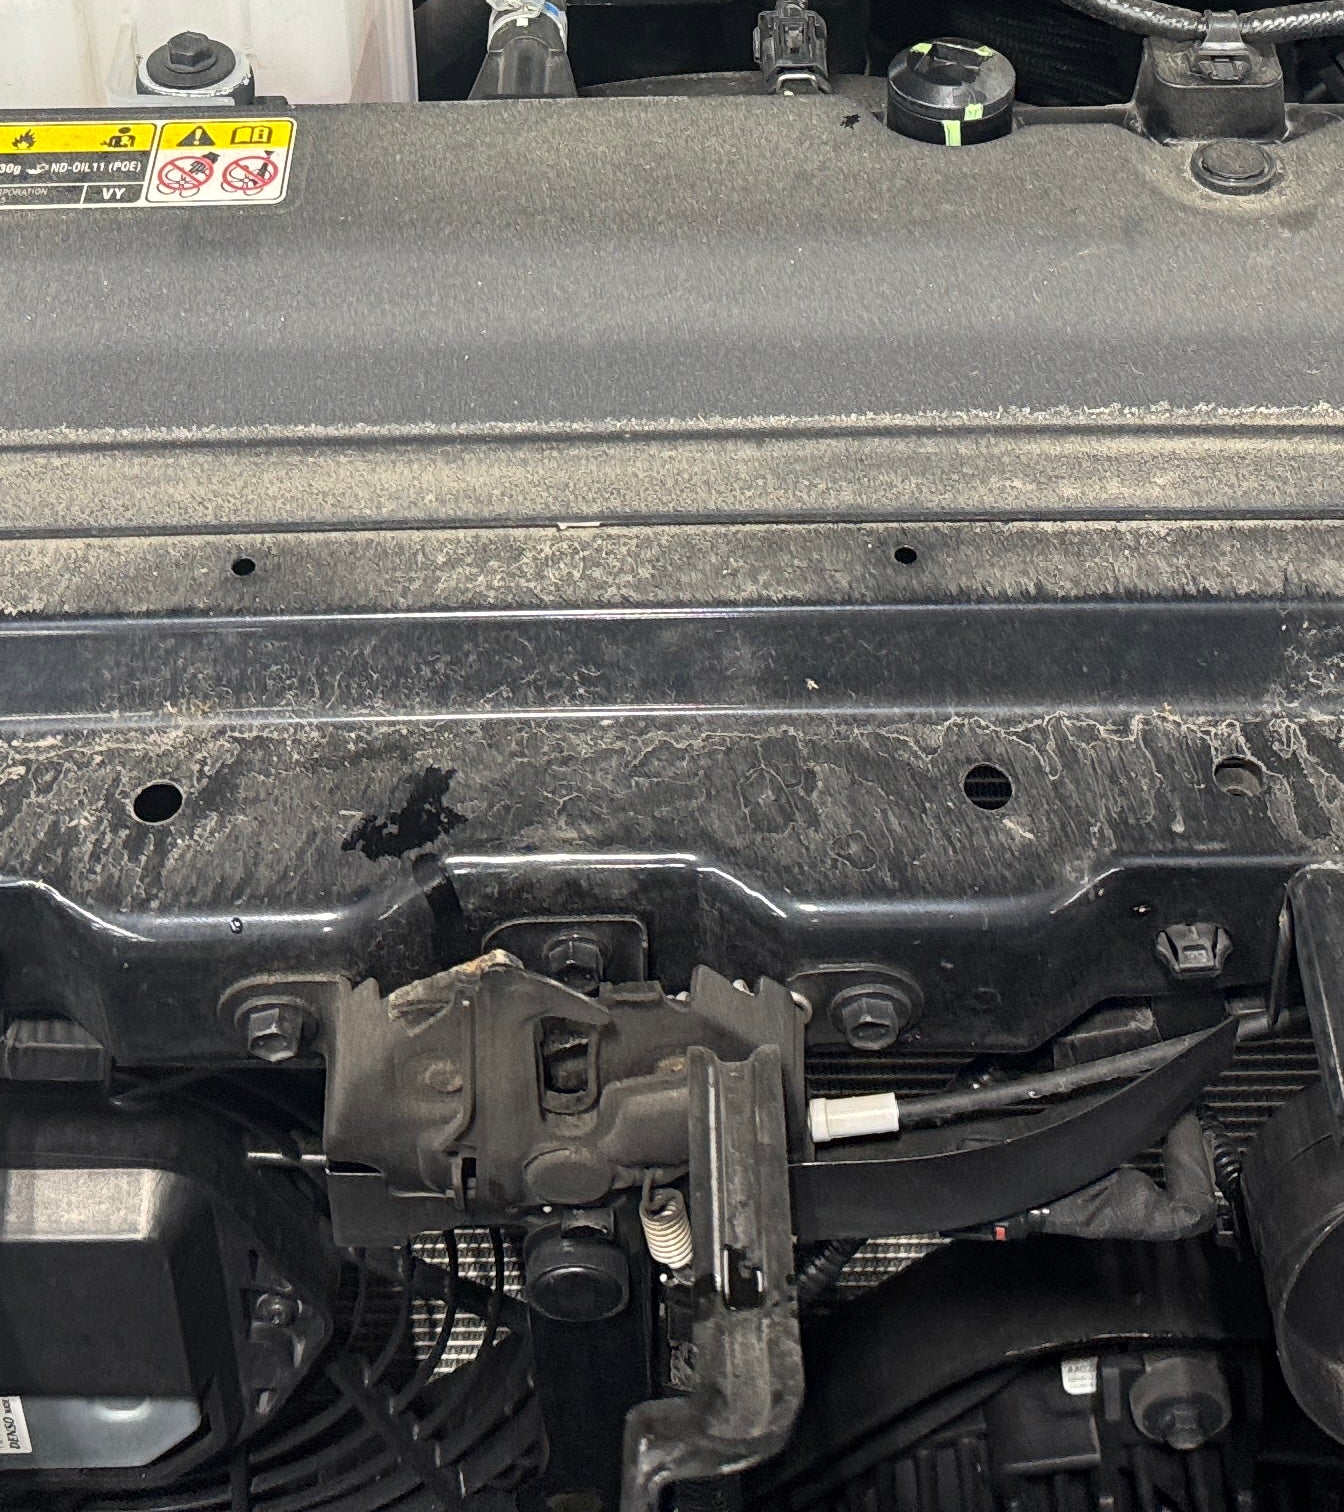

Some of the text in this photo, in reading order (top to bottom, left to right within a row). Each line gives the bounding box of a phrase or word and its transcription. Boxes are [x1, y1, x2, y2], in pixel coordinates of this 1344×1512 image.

[107, 161, 142, 174] (POE)
[101, 187, 127, 200] VY
[2, 1416, 22, 1450] DENSO
